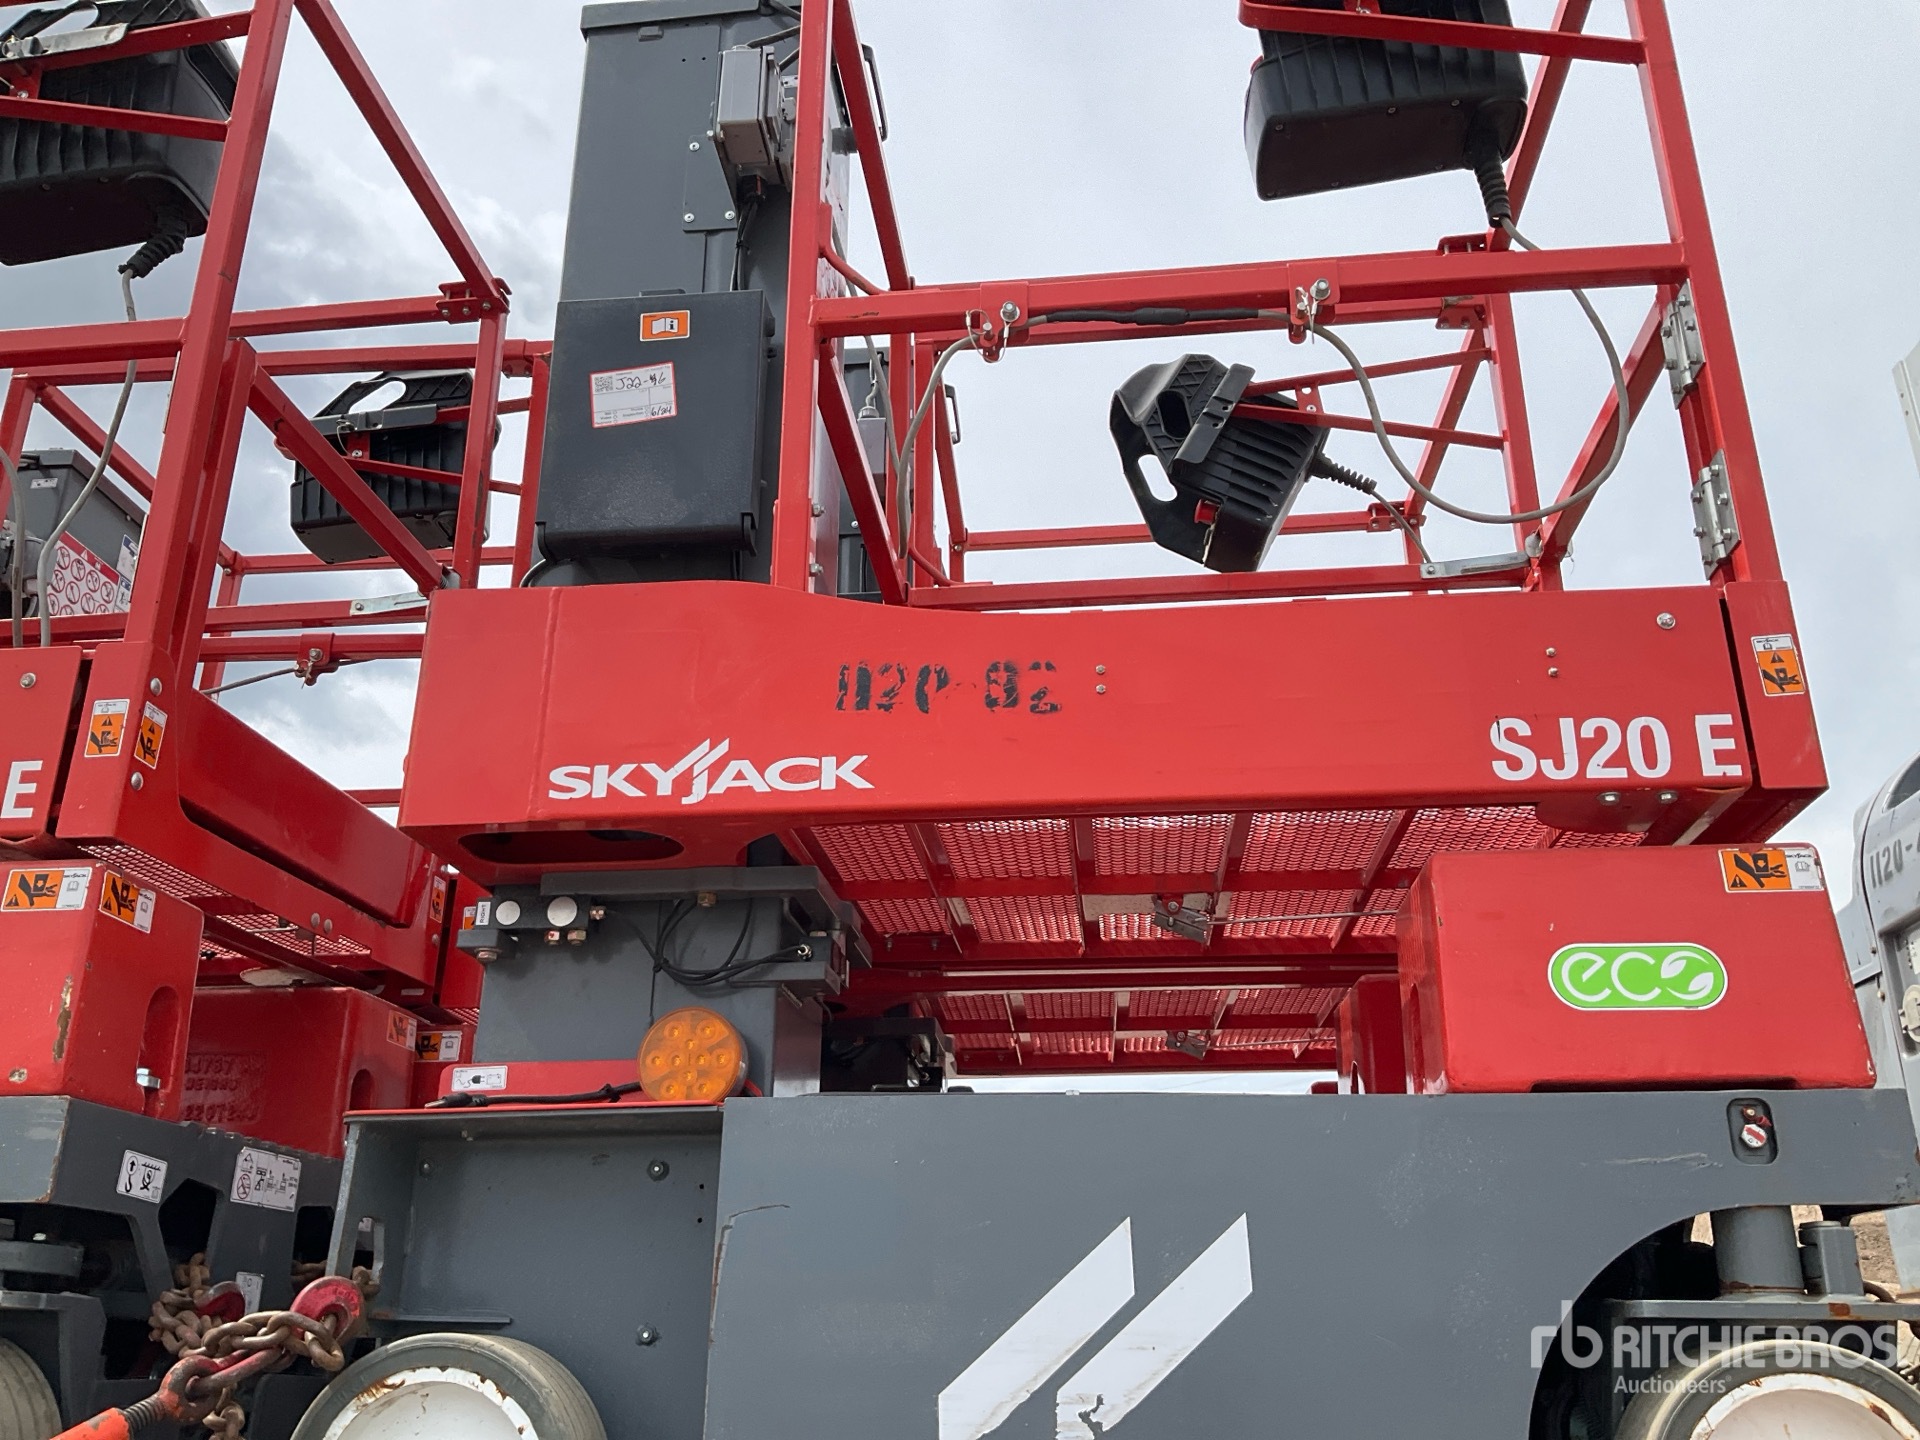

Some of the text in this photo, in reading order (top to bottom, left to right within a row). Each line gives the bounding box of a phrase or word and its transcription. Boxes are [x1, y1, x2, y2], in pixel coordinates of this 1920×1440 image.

[548, 738, 875, 805] SKYJACK
[1490, 713, 1743, 781] SJ20 E
[0, 760, 43, 819] E
[479, 904, 487, 924] RIGHT
